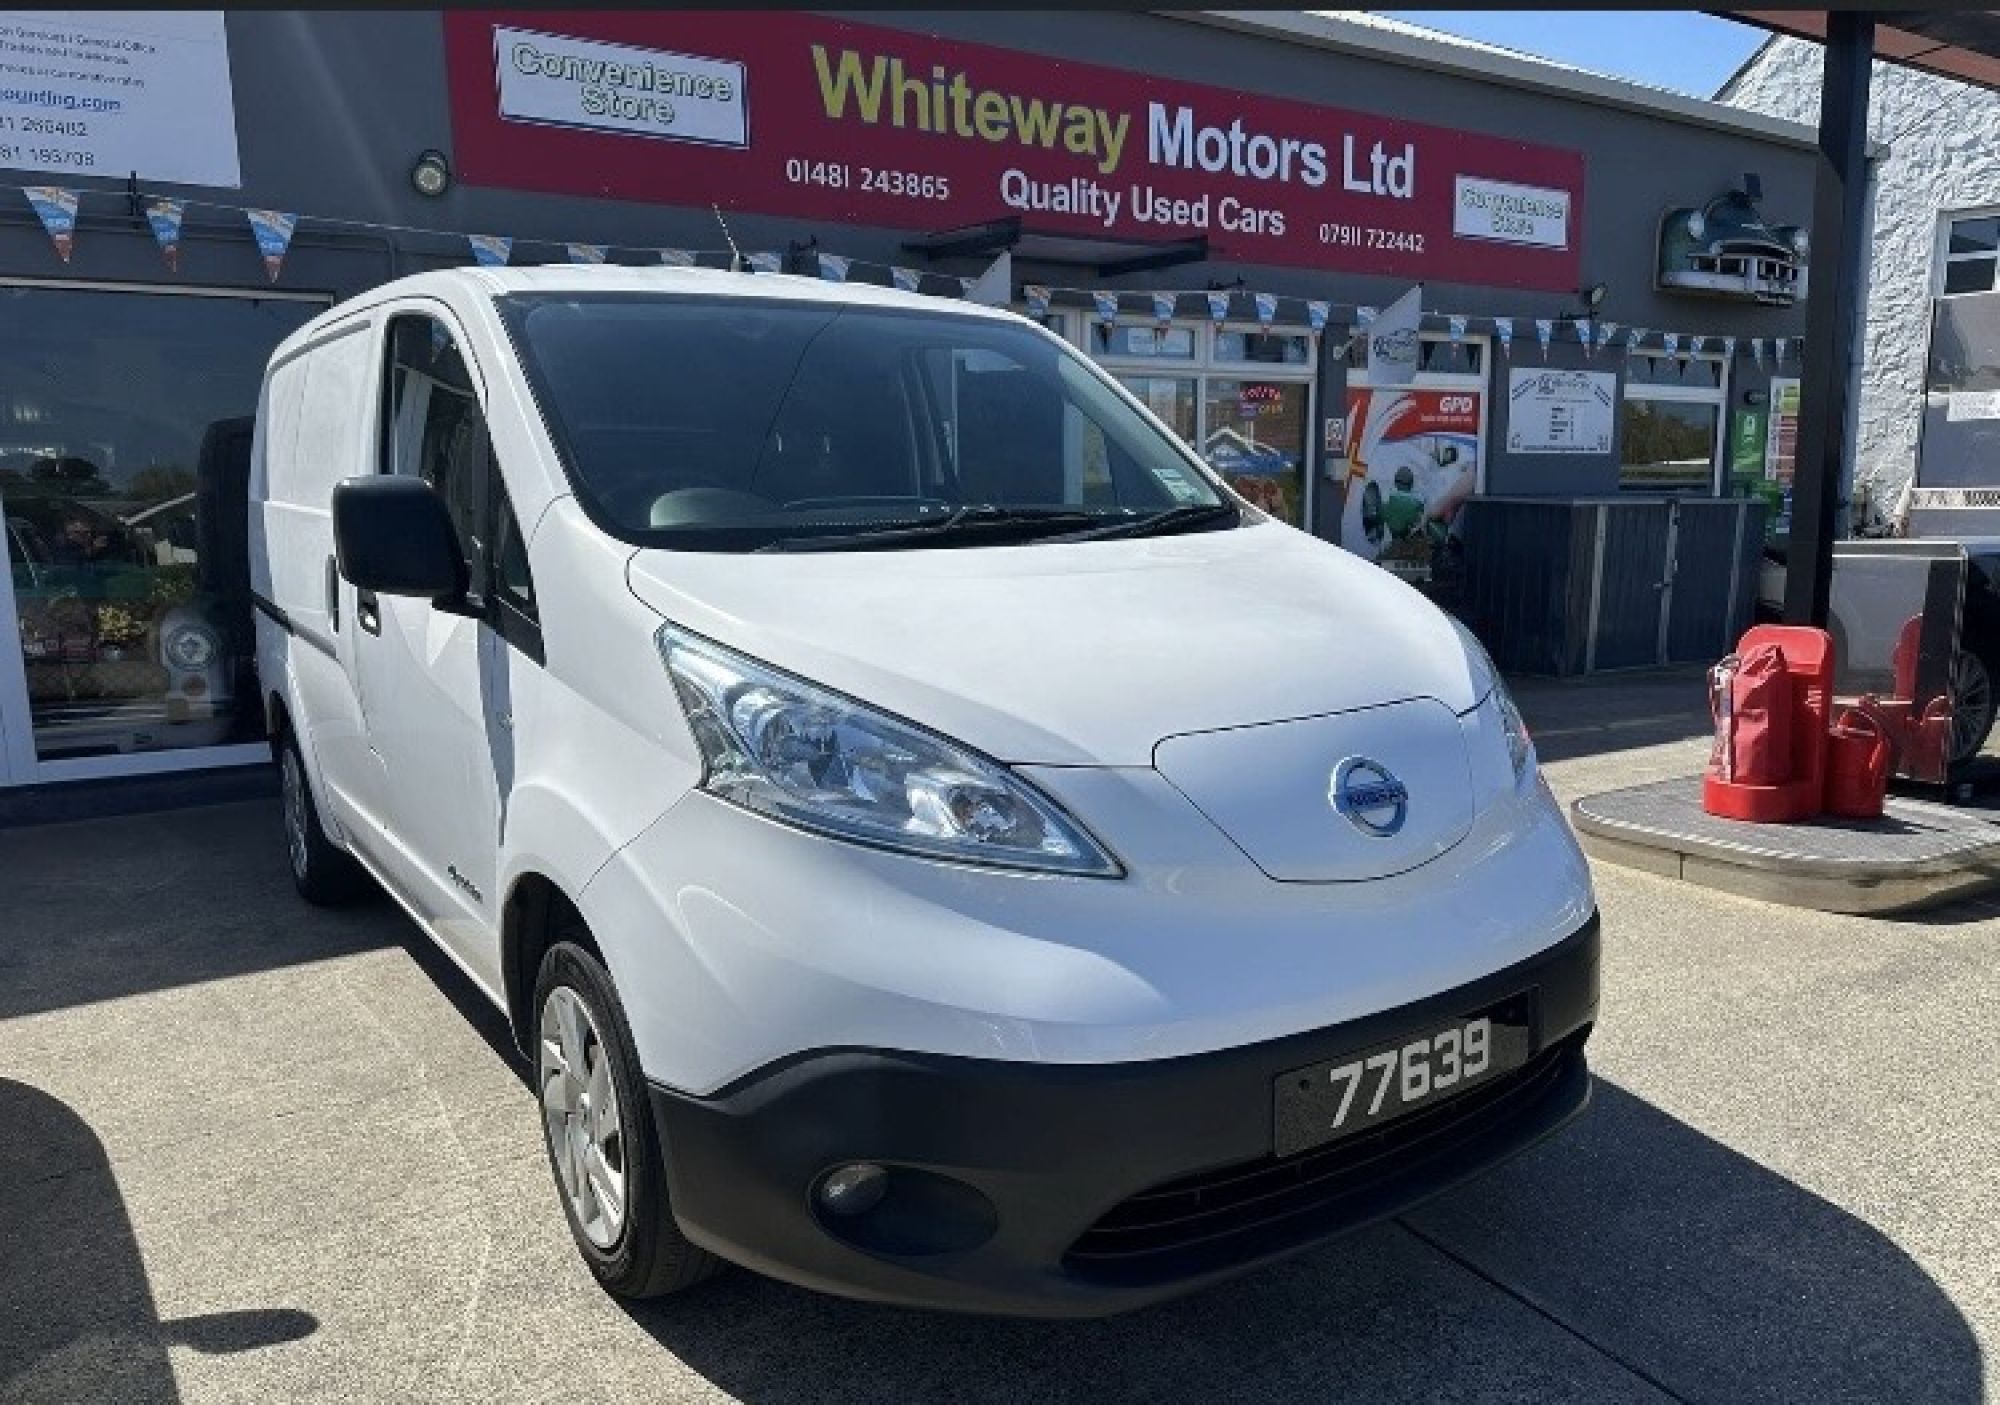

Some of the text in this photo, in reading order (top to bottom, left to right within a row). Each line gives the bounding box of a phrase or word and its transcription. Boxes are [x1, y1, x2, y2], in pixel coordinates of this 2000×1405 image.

[512, 42, 734, 101] Convenience
[580, 84, 676, 125] Store
[811, 44, 1414, 198] Whiteway Motors Ltd
[786, 158, 950, 201] 01481 243865
[1000, 169, 1286, 236] Quality Used Cars
[1319, 223, 1425, 254] 07911 722442
[1329, 1016, 1491, 1129] 77639
